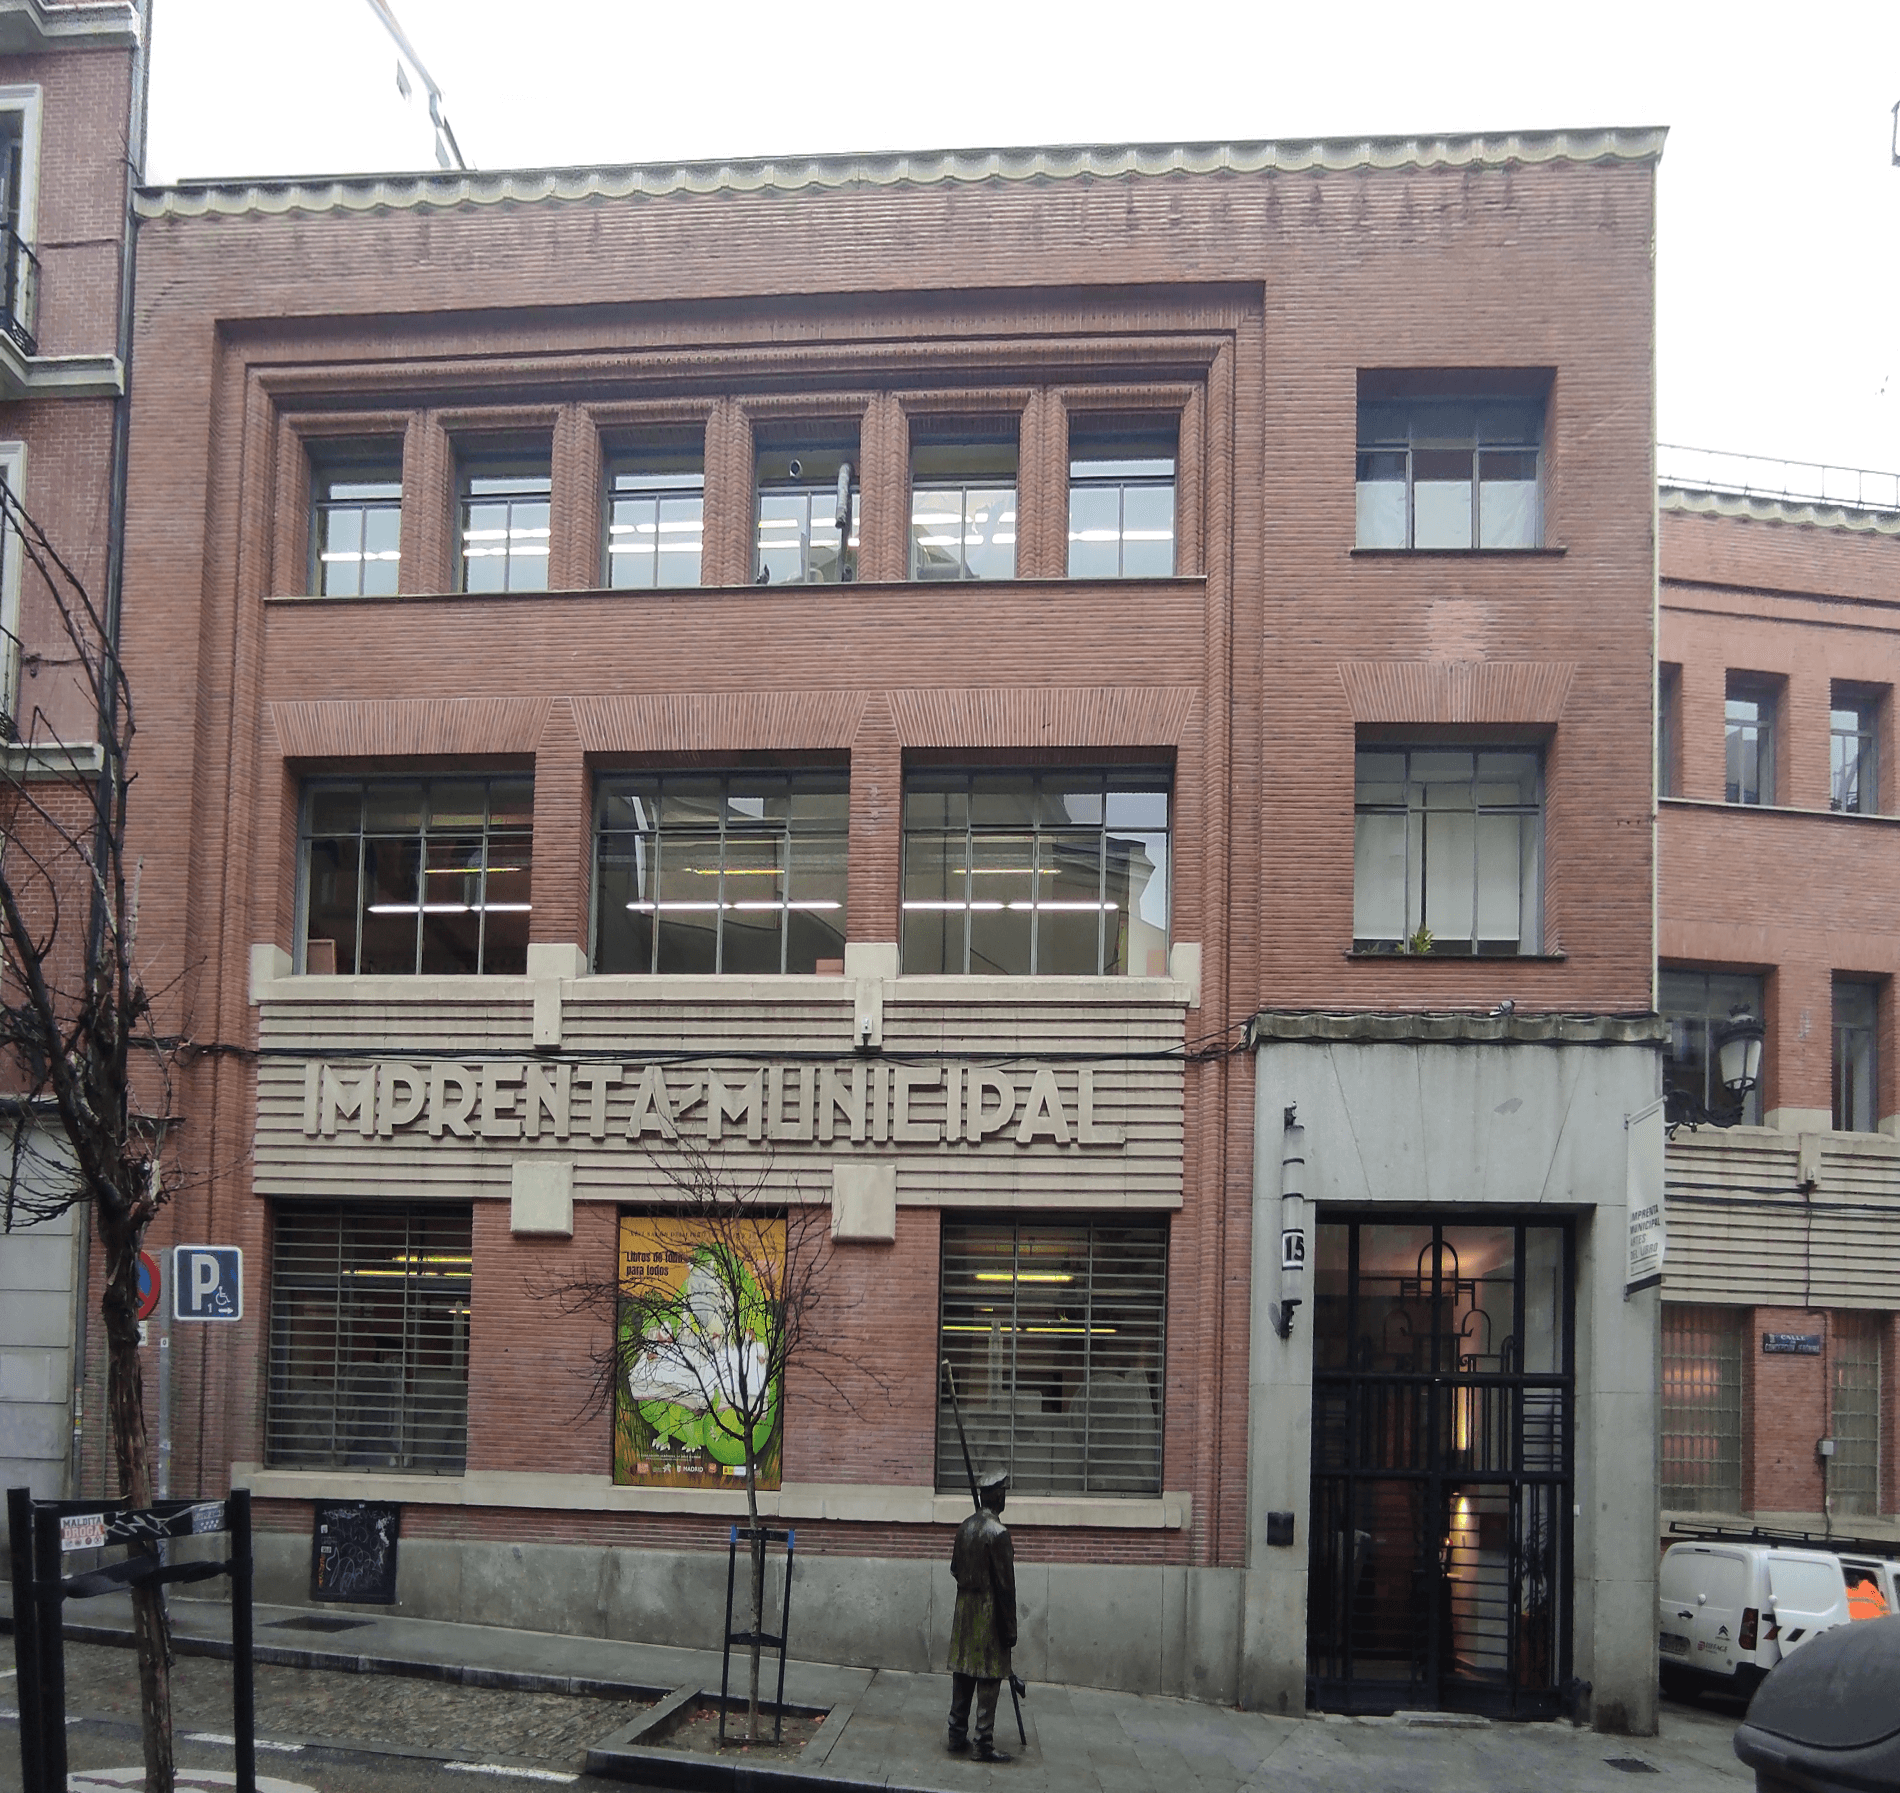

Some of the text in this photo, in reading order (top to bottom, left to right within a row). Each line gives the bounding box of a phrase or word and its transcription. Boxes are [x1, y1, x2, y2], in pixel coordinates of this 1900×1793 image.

[302, 1063, 1126, 1144] IMPRENTA MUNICIPAL
[1285, 1236, 1304, 1260] 15
[626, 1265, 669, 1277] para todos
[191, 1253, 220, 1310] P
[63, 1516, 101, 1528] MALDITA
[64, 1525, 102, 1538] DROGA
